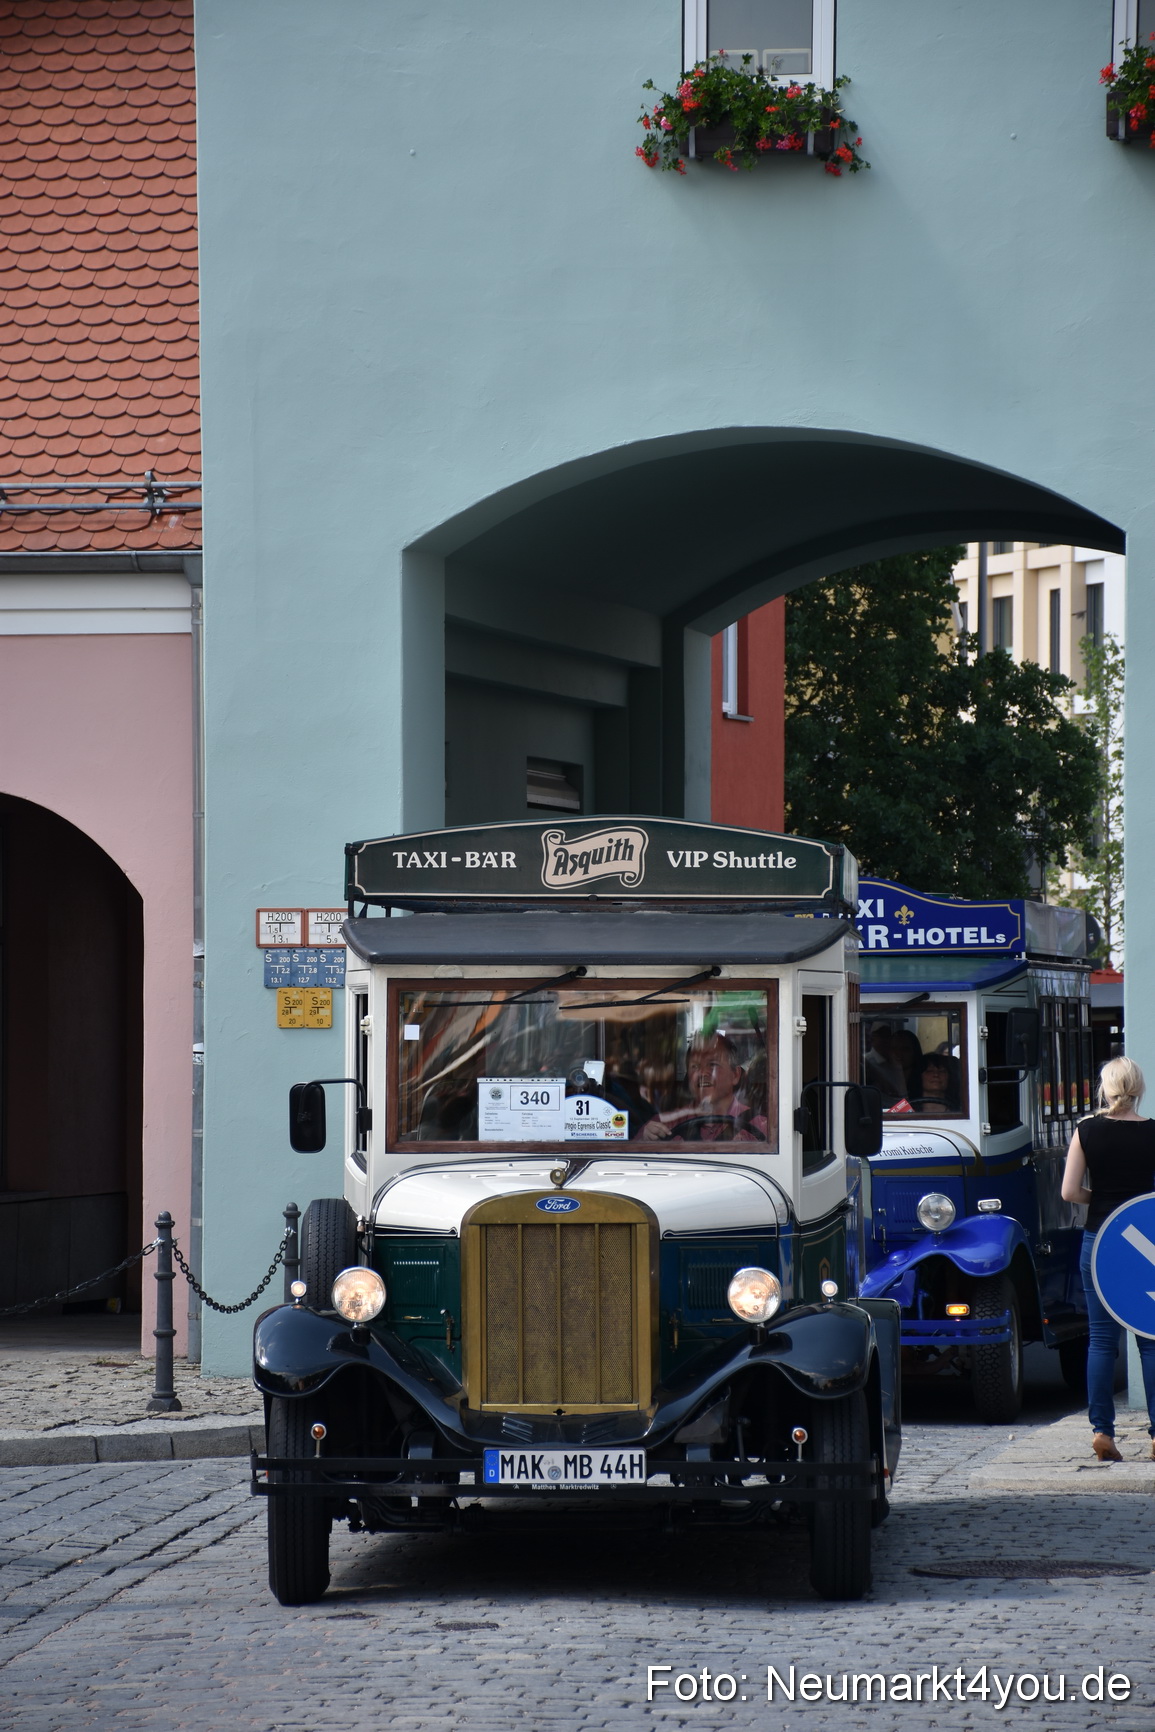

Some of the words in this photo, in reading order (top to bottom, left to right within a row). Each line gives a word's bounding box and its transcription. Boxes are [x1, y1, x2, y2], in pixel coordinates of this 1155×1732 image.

[552, 838, 634, 876] Asquith
[667, 851, 708, 868] VIP
[713, 851, 797, 868] Shuttle
[856, 899, 884, 918] XI
[265, 954, 272, 963] S
[292, 954, 299, 963] S
[320, 954, 326, 963] S
[284, 997, 291, 1006] S
[311, 997, 318, 1006] S
[520, 1091, 550, 1105] 340
[576, 1100, 589, 1116] 31
[578, 1122, 595, 1131] Egrensis
[596, 1119, 611, 1129] Classic
[901, 1145, 934, 1156] Kutsche
[545, 1199, 571, 1210] Ford
[501, 1454, 544, 1479] MAK
[564, 1454, 593, 1479] MB
[600, 1454, 643, 1479] 44H
